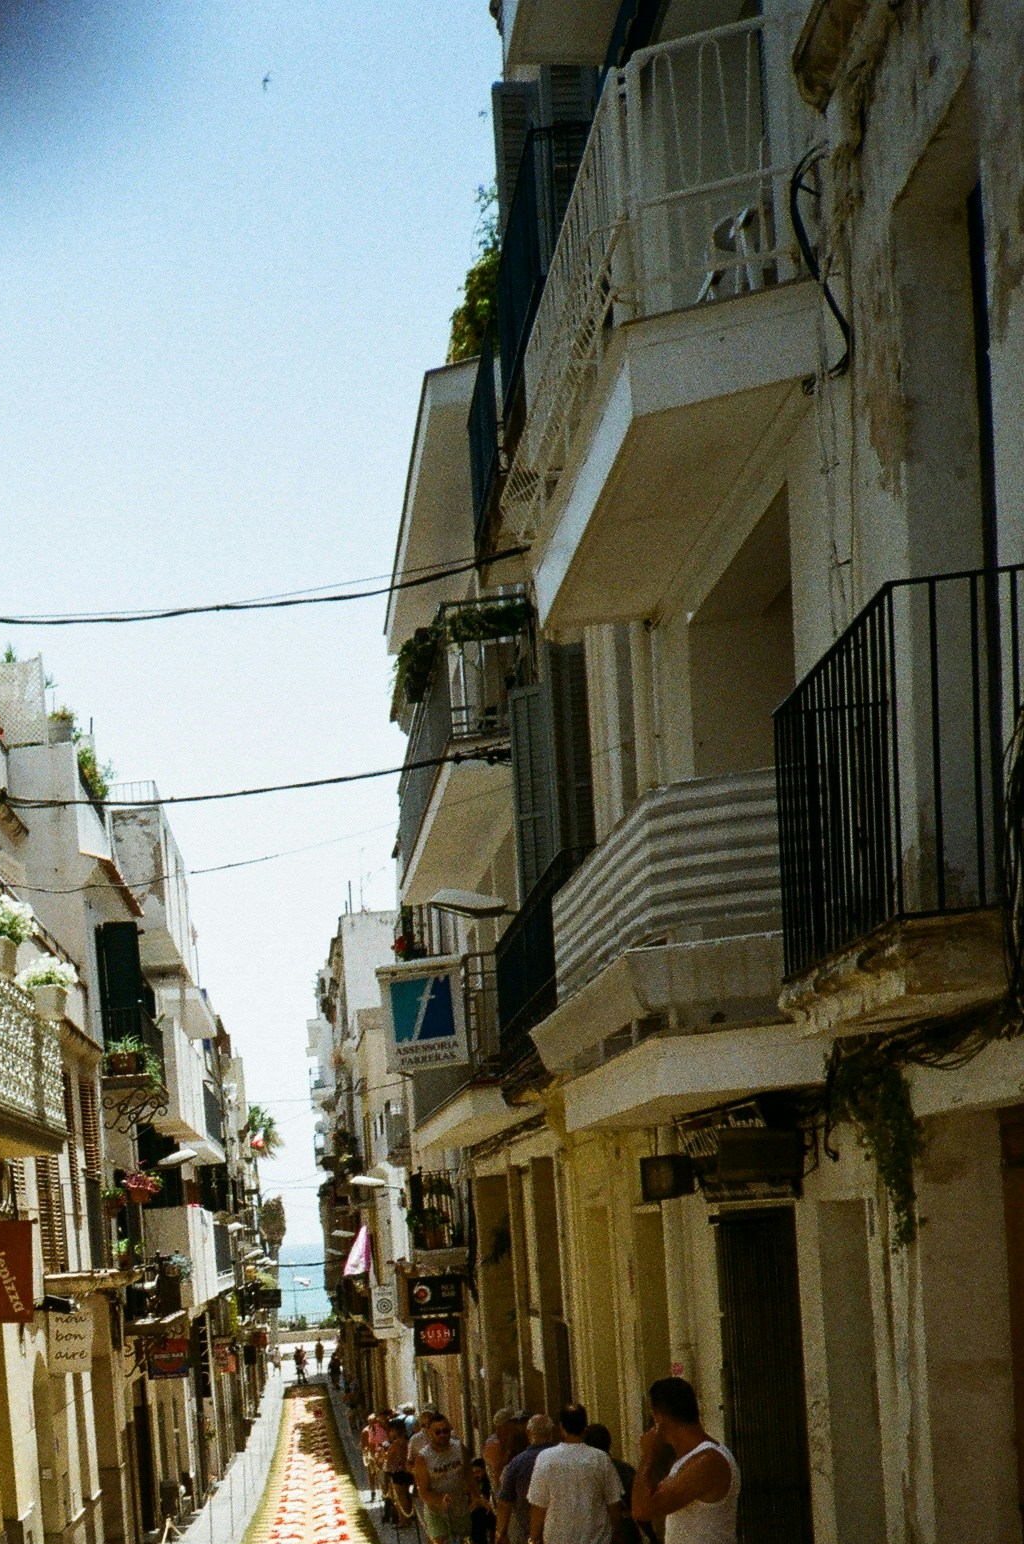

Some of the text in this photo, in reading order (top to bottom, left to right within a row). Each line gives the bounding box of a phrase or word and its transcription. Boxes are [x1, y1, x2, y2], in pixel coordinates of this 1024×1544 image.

[55, 1329, 86, 1342] bon
[420, 1328, 456, 1339] SUSHI
[55, 1348, 88, 1359] aire
